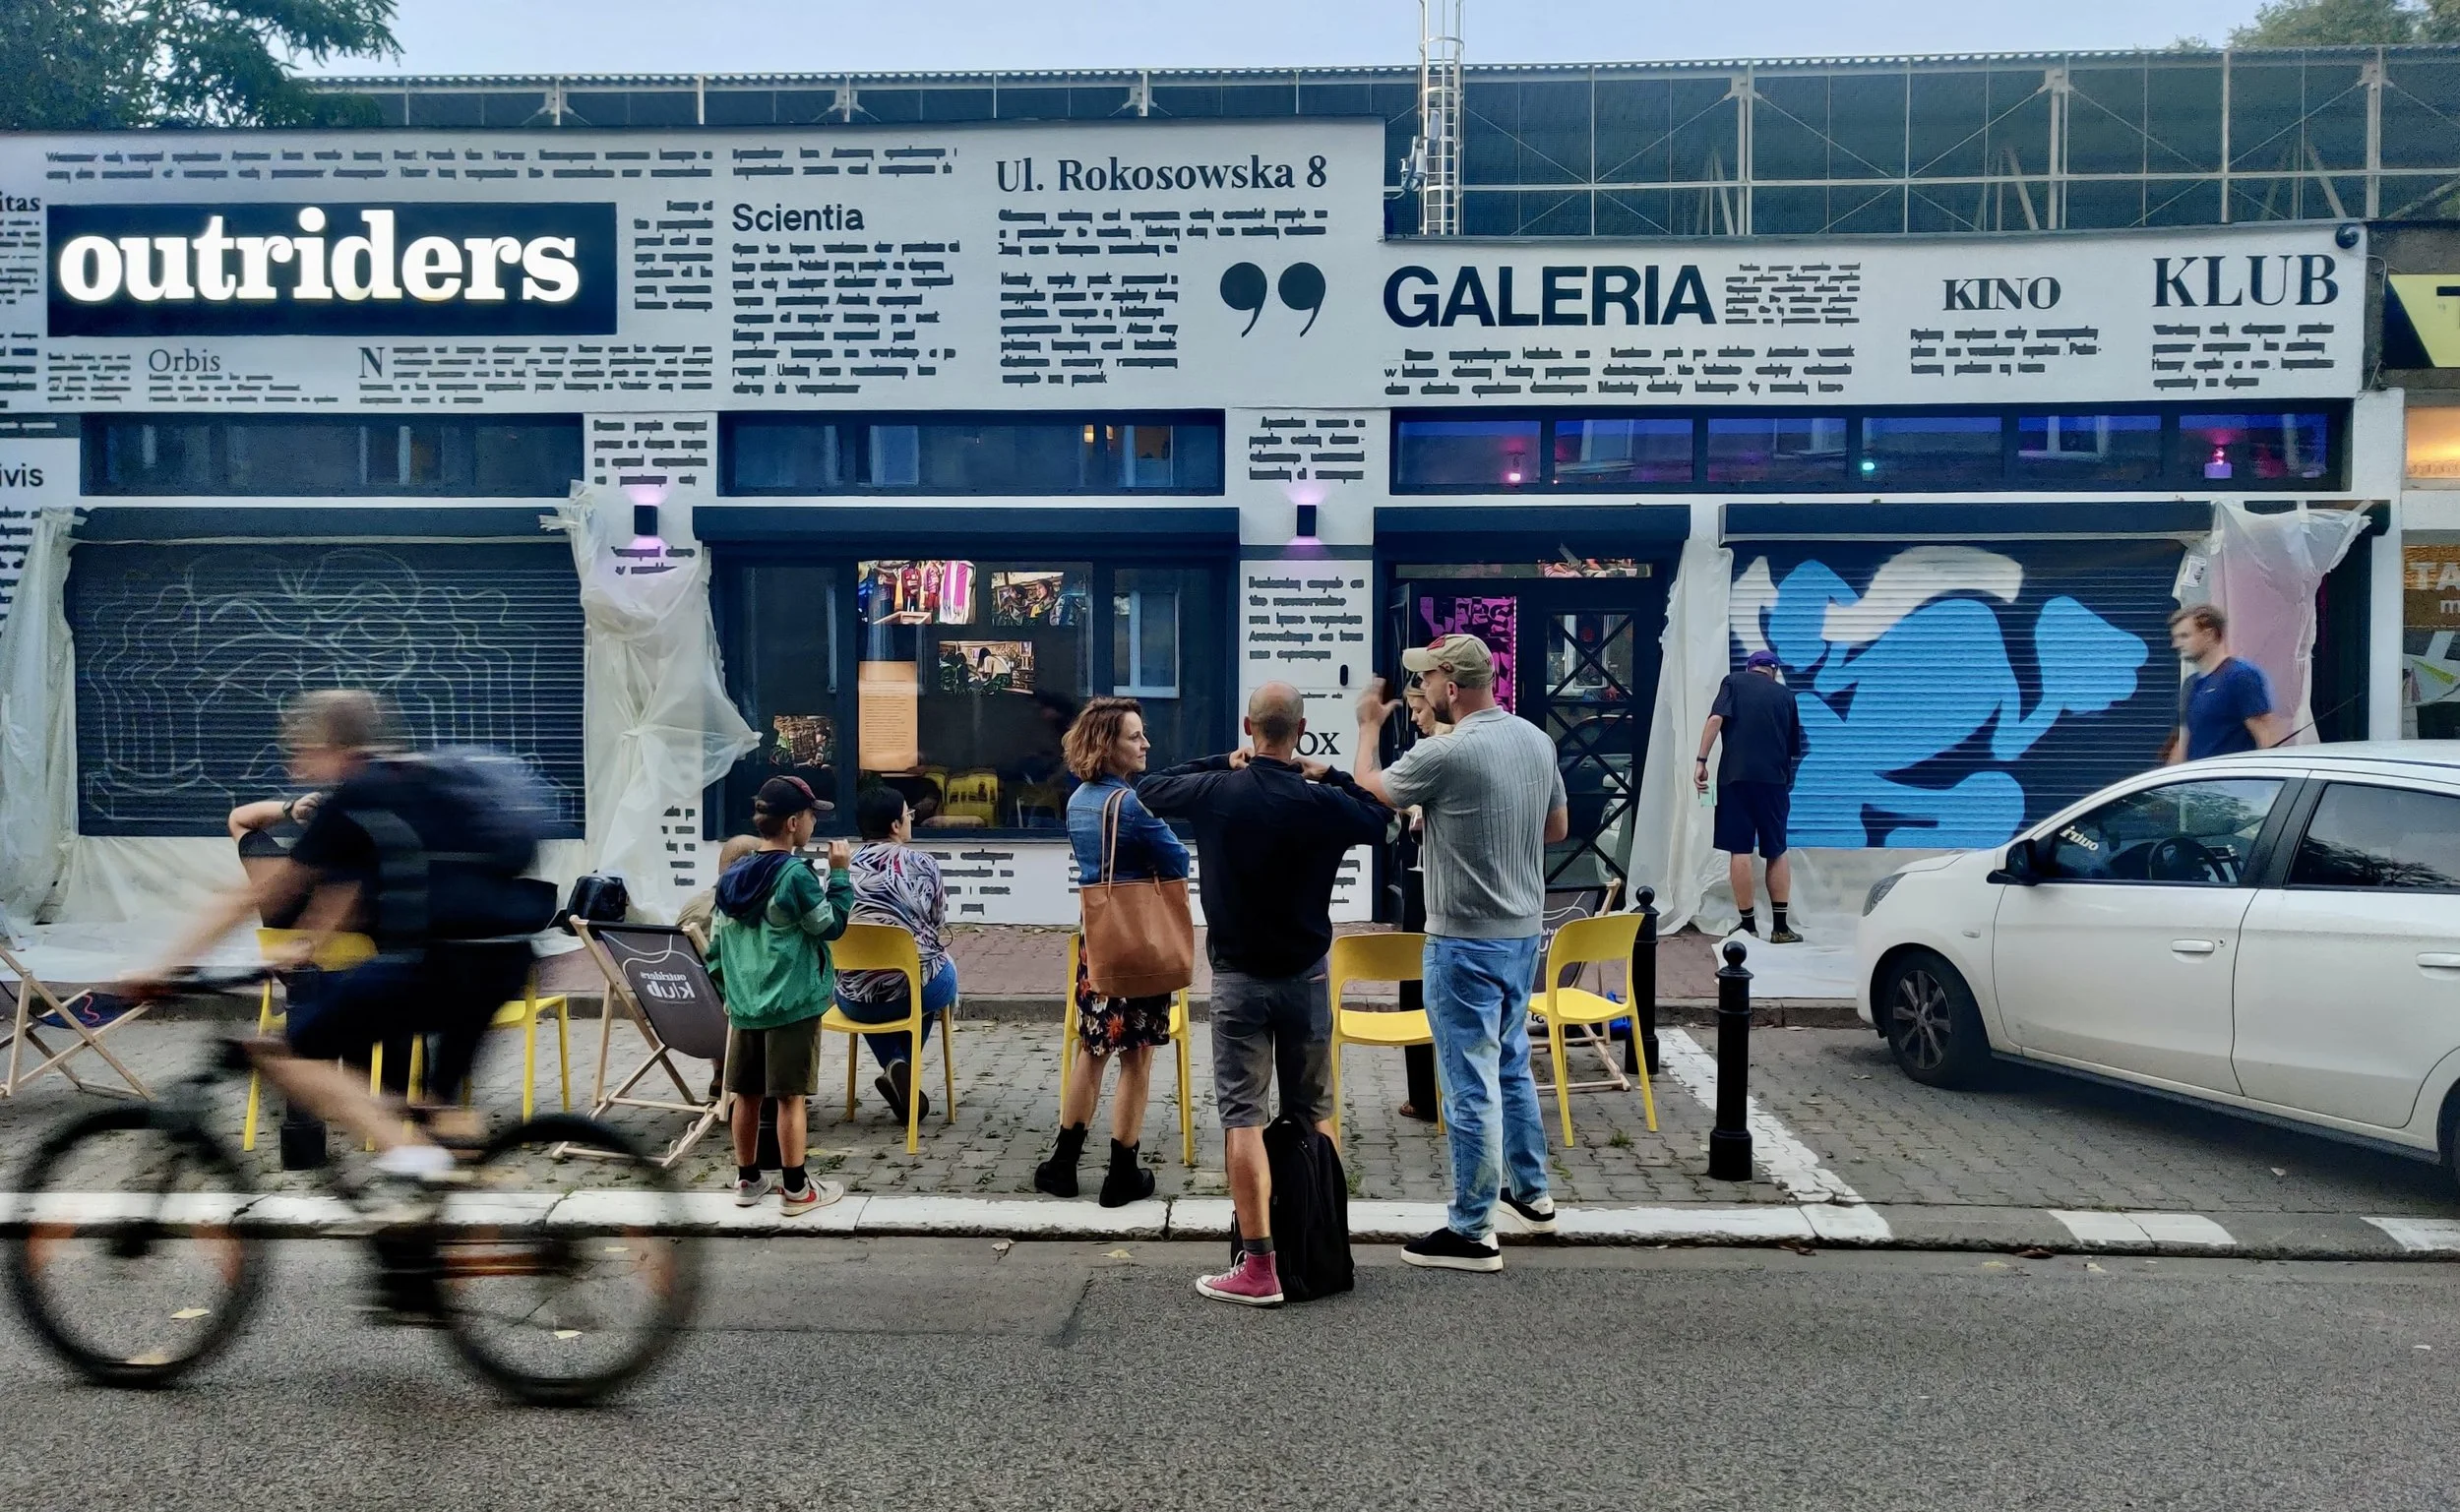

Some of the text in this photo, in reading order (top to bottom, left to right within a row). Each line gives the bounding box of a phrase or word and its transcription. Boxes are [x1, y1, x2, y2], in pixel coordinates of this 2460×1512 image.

[996, 157, 1044, 193] Ul.
[1058, 155, 1295, 191] Rokosowska
[1307, 155, 1327, 188] 8
[732, 203, 865, 232] Scientia
[59, 207, 580, 301] outriders
[1383, 265, 1717, 328] GALERIA
[1942, 276, 2061, 311] KINO
[2152, 254, 2340, 308] KLUB
[149, 348, 221, 372] Orbis
[358, 347, 386, 379] N
[1295, 731, 1341, 756] ox
